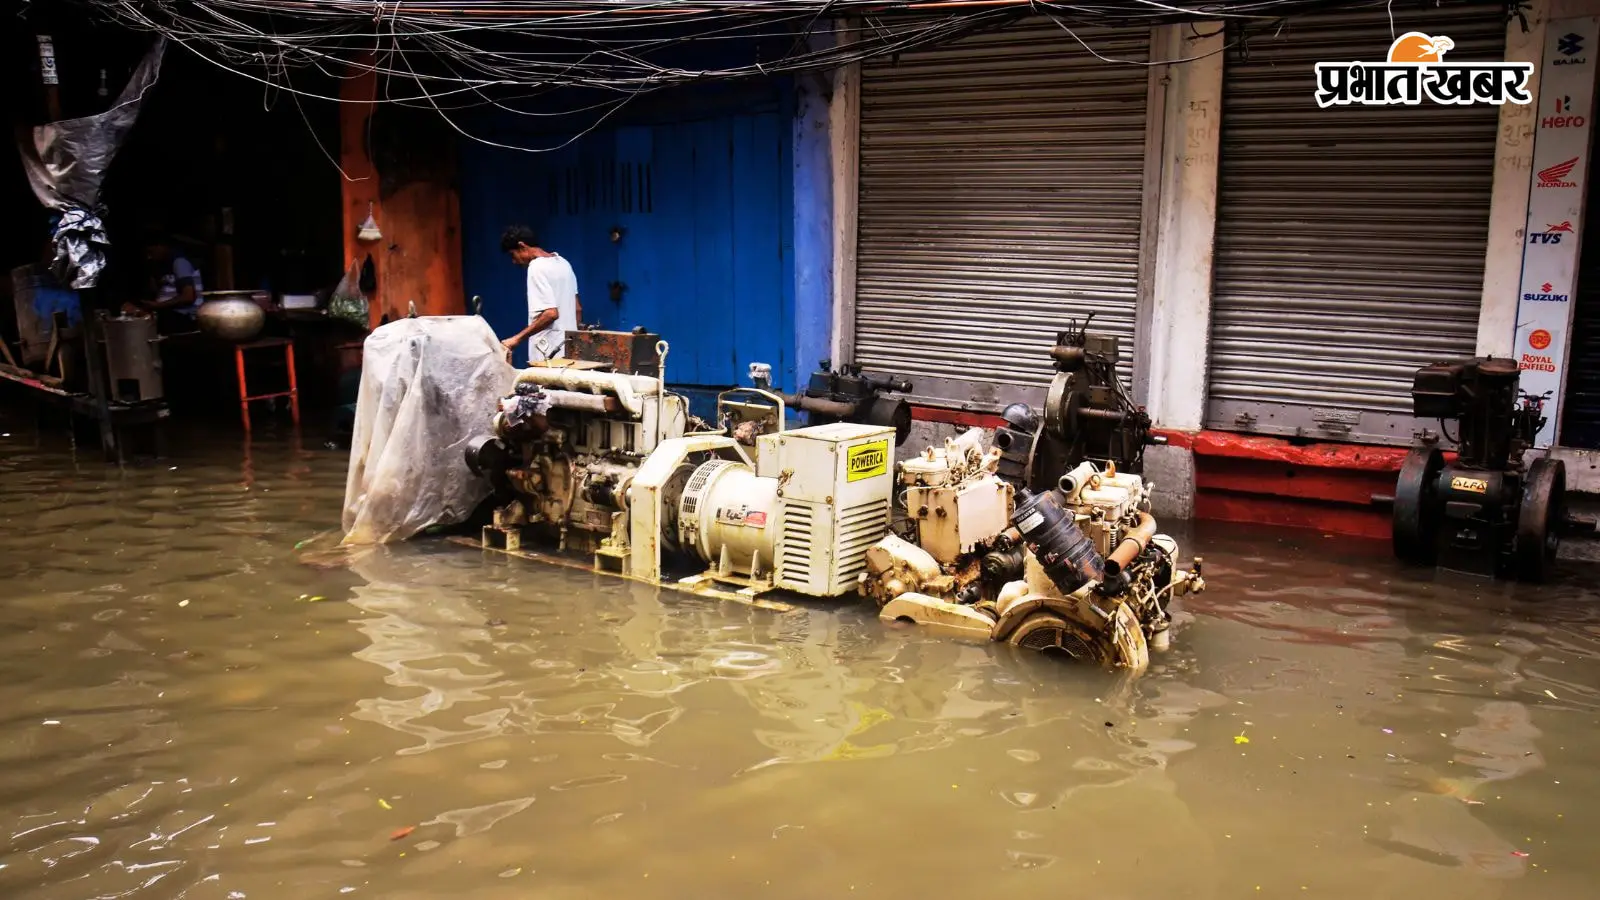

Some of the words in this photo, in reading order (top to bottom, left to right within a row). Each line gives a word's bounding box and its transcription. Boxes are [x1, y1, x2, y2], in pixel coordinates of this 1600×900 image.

[1553, 58, 1586, 66] BAJAJ
[1542, 115, 1584, 128] Hero
[1530, 233, 1561, 244] TVS
[1523, 293, 1568, 302] SUZUKI
[1522, 354, 1552, 363] ROYAL
[1519, 362, 1555, 372] ENFIELD
[852, 452, 883, 469] POWERICA
[1453, 480, 1485, 490] ALFA
